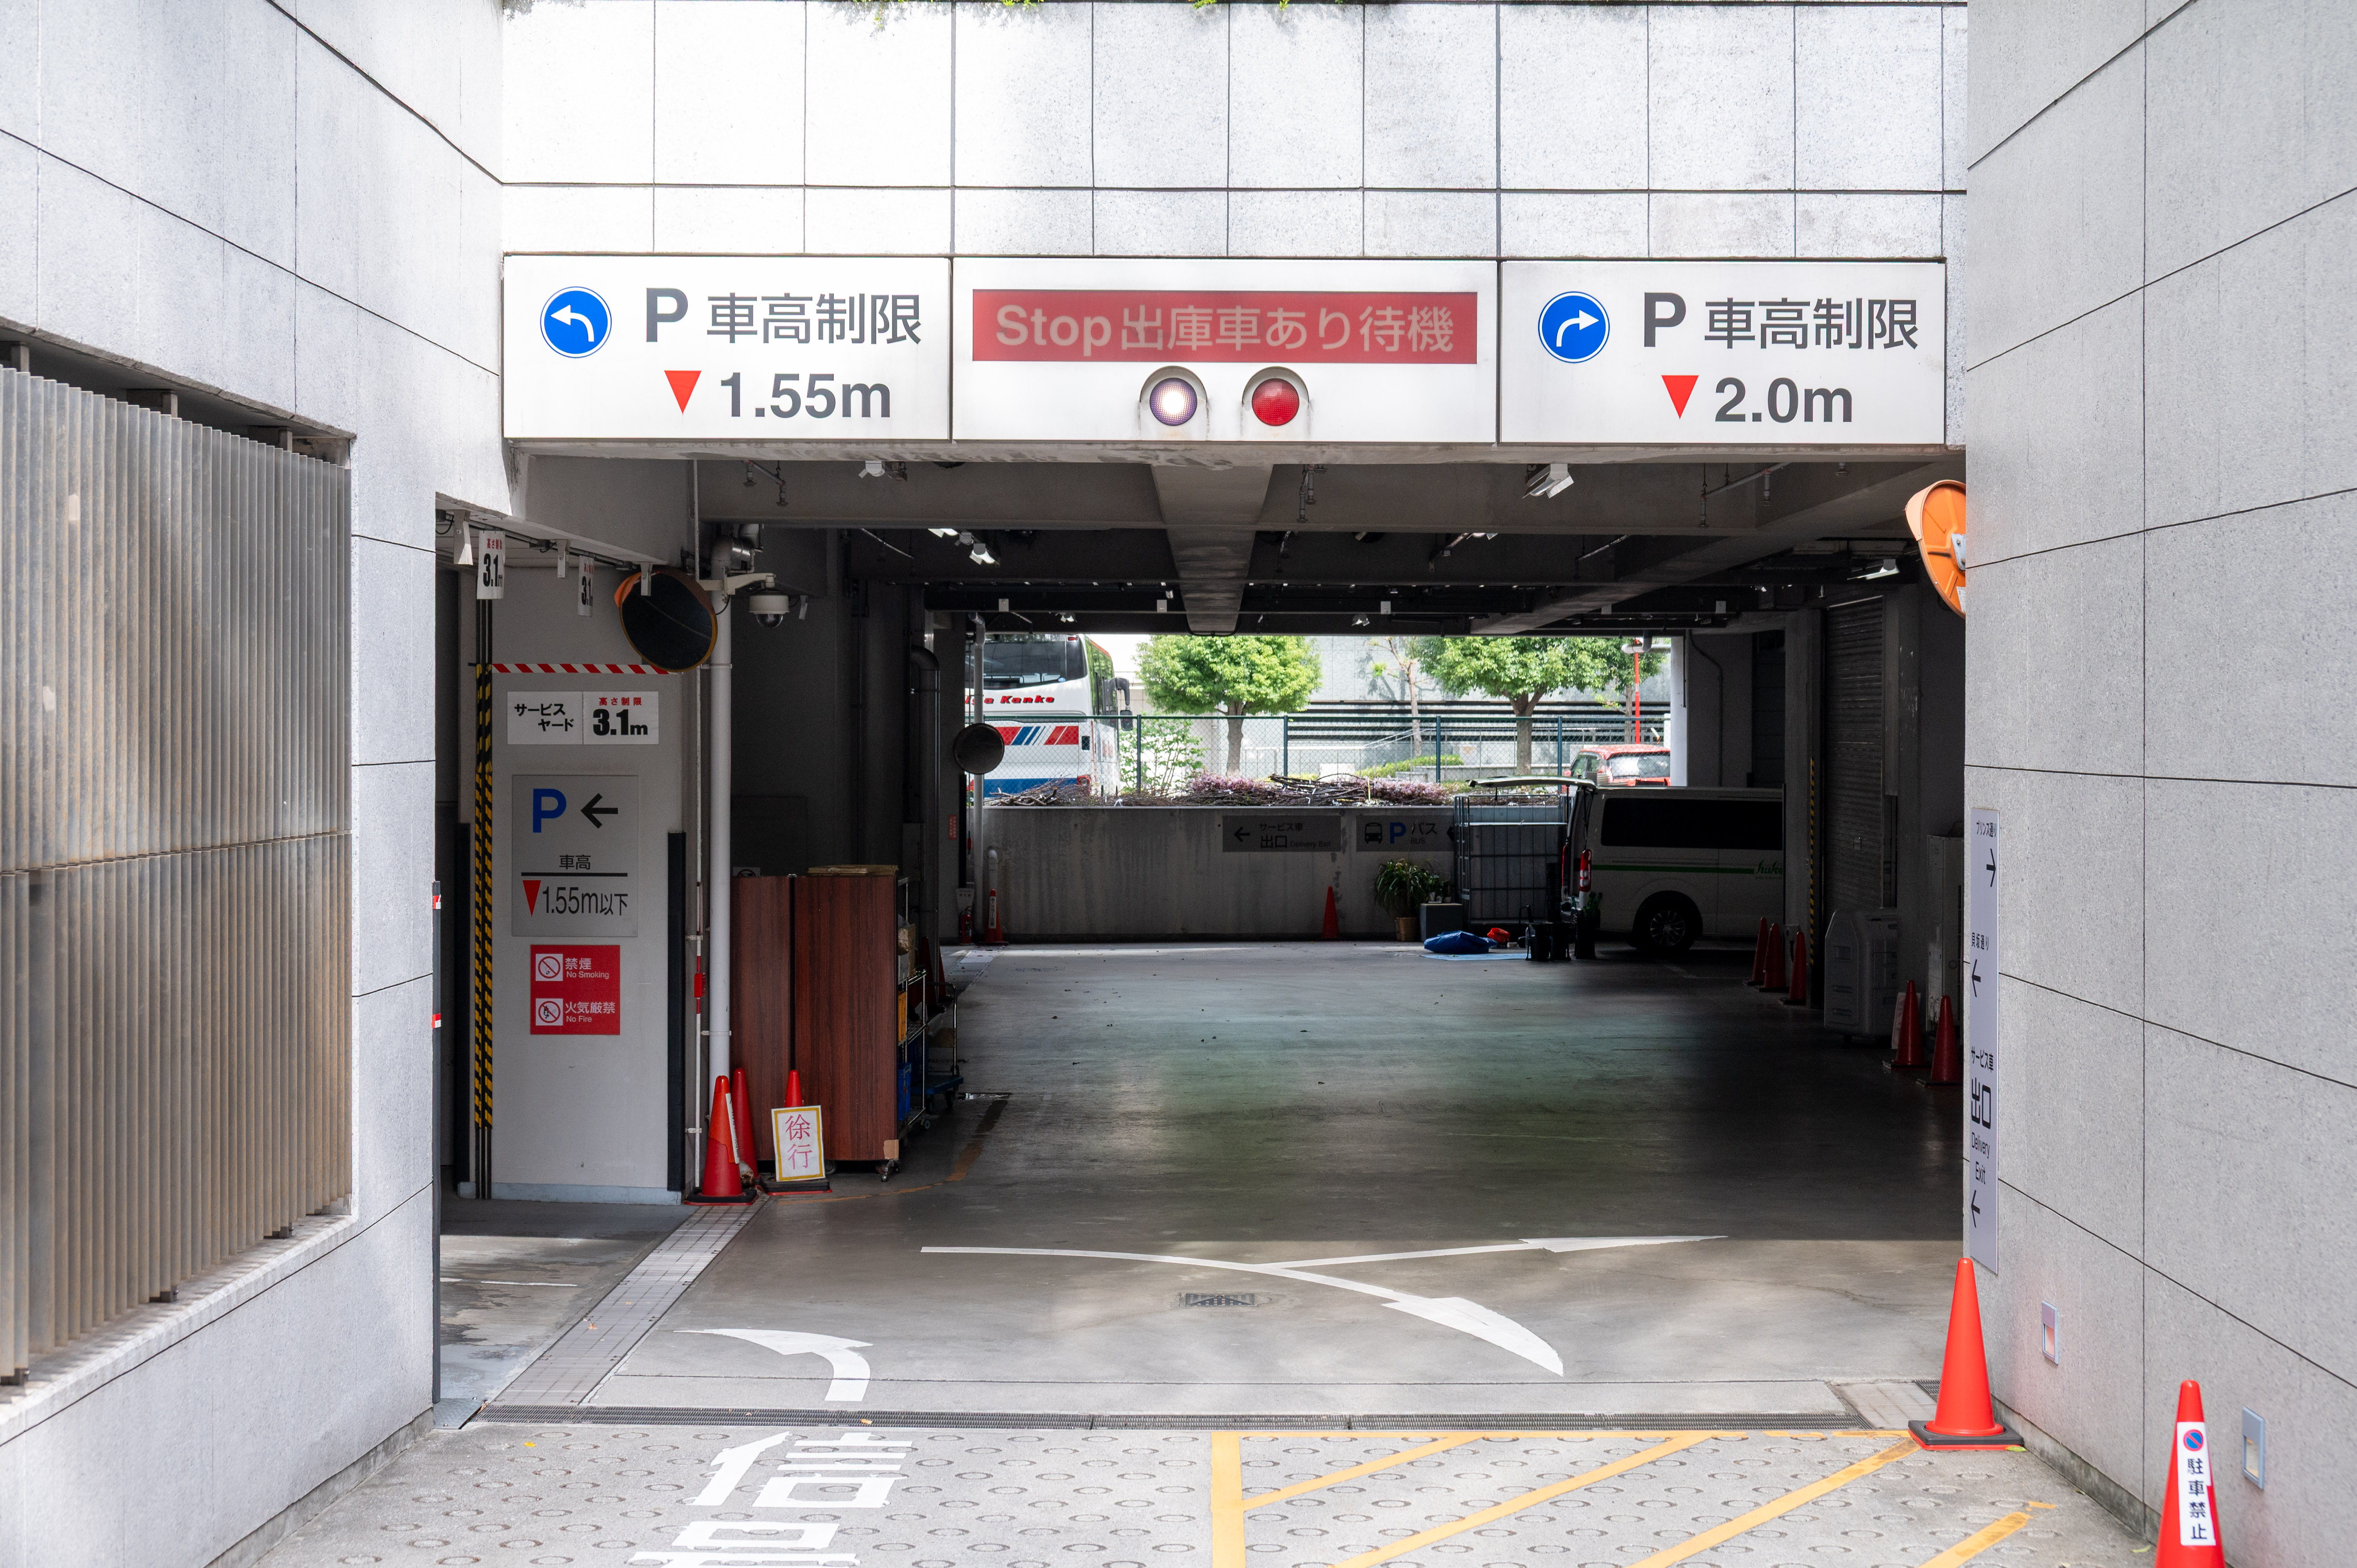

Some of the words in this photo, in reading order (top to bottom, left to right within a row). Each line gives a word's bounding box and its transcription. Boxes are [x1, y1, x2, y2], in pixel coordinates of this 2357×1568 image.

[646, 287, 688, 342] P
[707, 292, 921, 345] 車高制限
[1643, 292, 1686, 347] P
[1704, 297, 1918, 350] 車高制限
[721, 372, 890, 418] 1.55m
[1715, 377, 1852, 423] 2.0m
[483, 553, 503, 587] 3.1m
[514, 703, 566, 716] サービス
[599, 697, 642, 705] 高さ制限
[1000, 695, 1054, 704] Kanko
[538, 718, 574, 731] ヤード
[593, 709, 648, 735] 3.1m
[533, 788, 567, 832] P
[1259, 823, 1303, 832] サービス車
[1390, 822, 1406, 844] P
[1411, 822, 1438, 835] バス
[1976, 820, 1996, 837] プリンス通り
[1260, 835, 1287, 849] 出口
[559, 855, 591, 870] 車高
[565, 958, 591, 970] 禁煙
[579, 971, 609, 979] Smoking
[565, 1002, 615, 1014] 火気厳禁
[1971, 1046, 1994, 1072] サービス車
[1971, 1077, 1991, 1130] 出口
[785, 1114, 813, 1169] 徐行
[1972, 1132, 1990, 1159] Delivery
[1975, 1161, 1986, 1185] Exit
[2188, 1458, 2207, 1540] 駐車禁止
